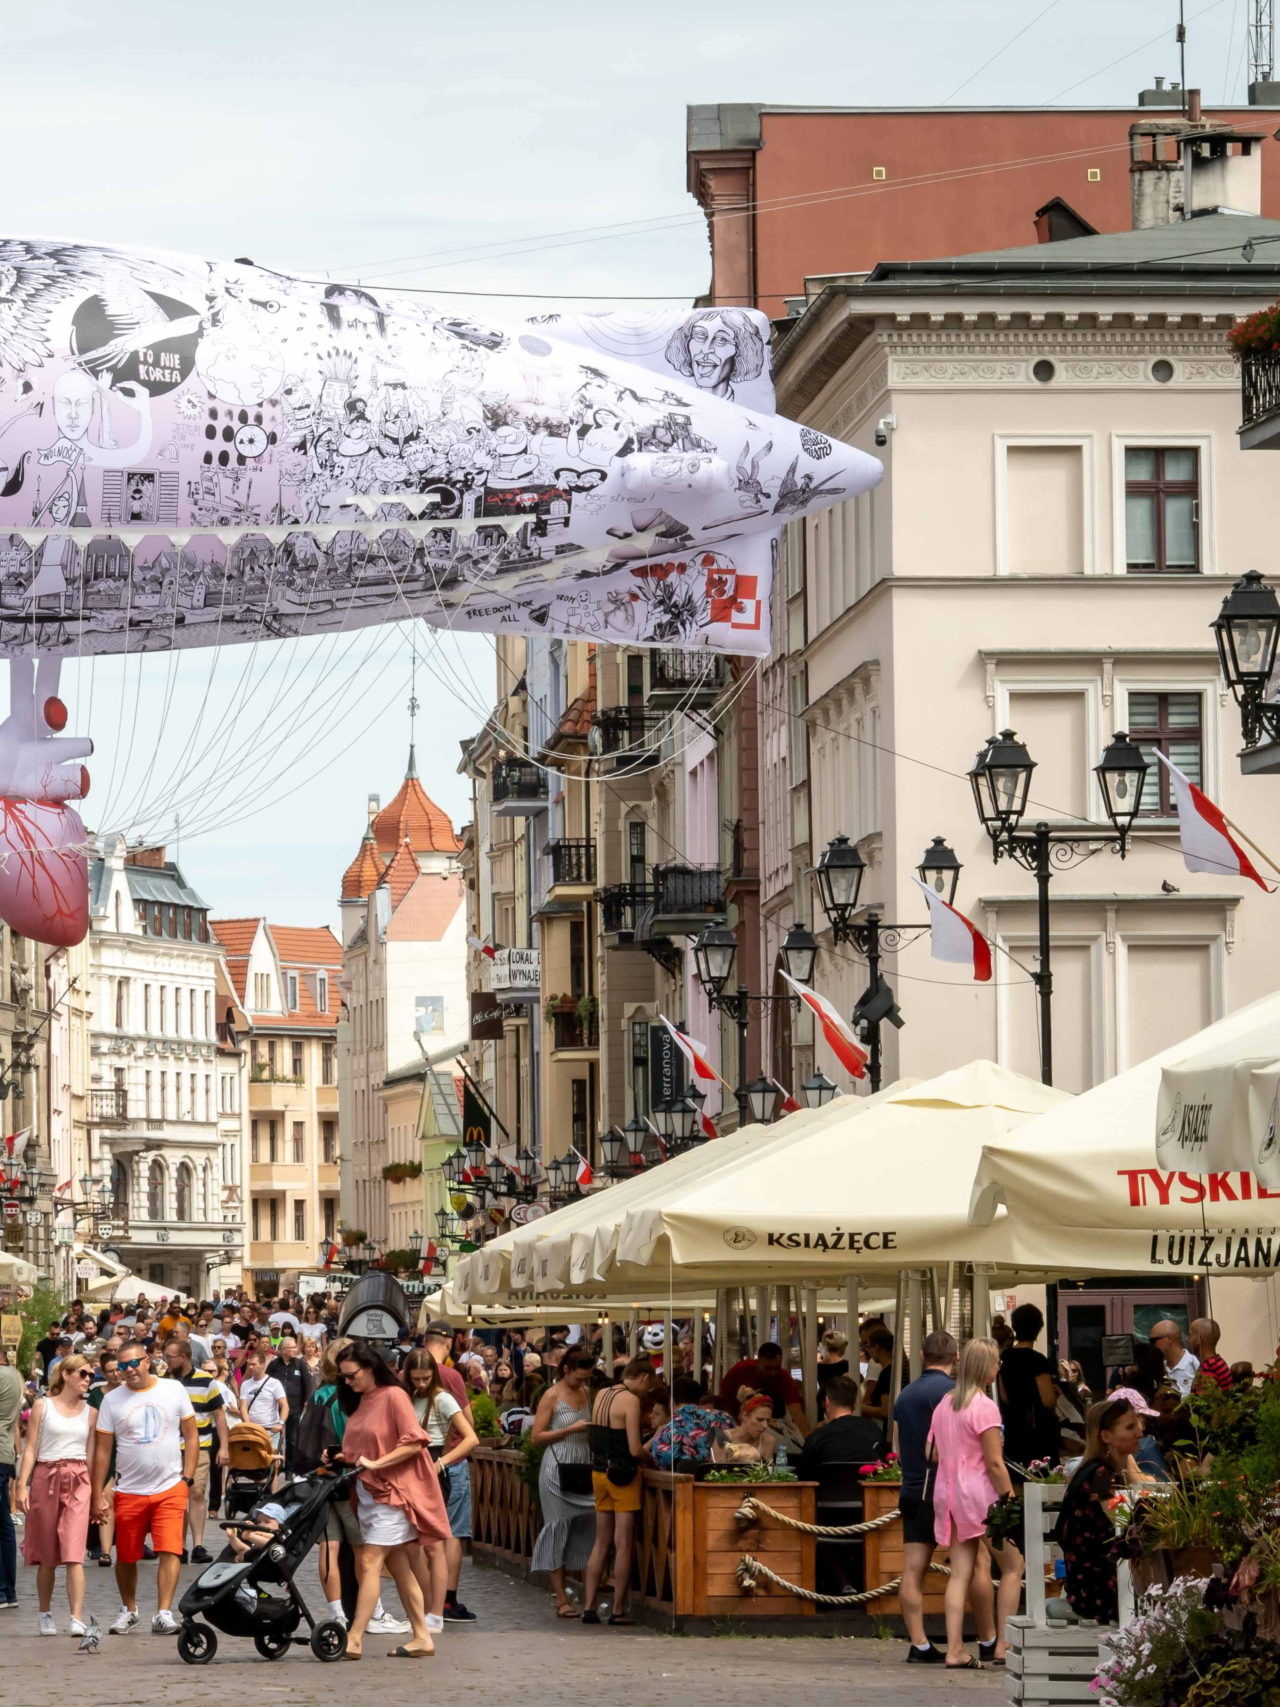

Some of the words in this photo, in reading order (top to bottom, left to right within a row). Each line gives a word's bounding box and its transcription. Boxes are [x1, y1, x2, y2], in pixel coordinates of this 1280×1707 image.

[138, 348, 154, 364] TO
[160, 352, 181, 368] NIE
[138, 364, 181, 383] KOREA
[465, 603, 512, 620] FREEDOM
[518, 599, 534, 609] FOR
[499, 613, 520, 623] ALL
[511, 951, 533, 965] LOKAL
[511, 969, 541, 986] WYNAJĘ
[767, 1227, 898, 1254] KSIĄŻĘCE
